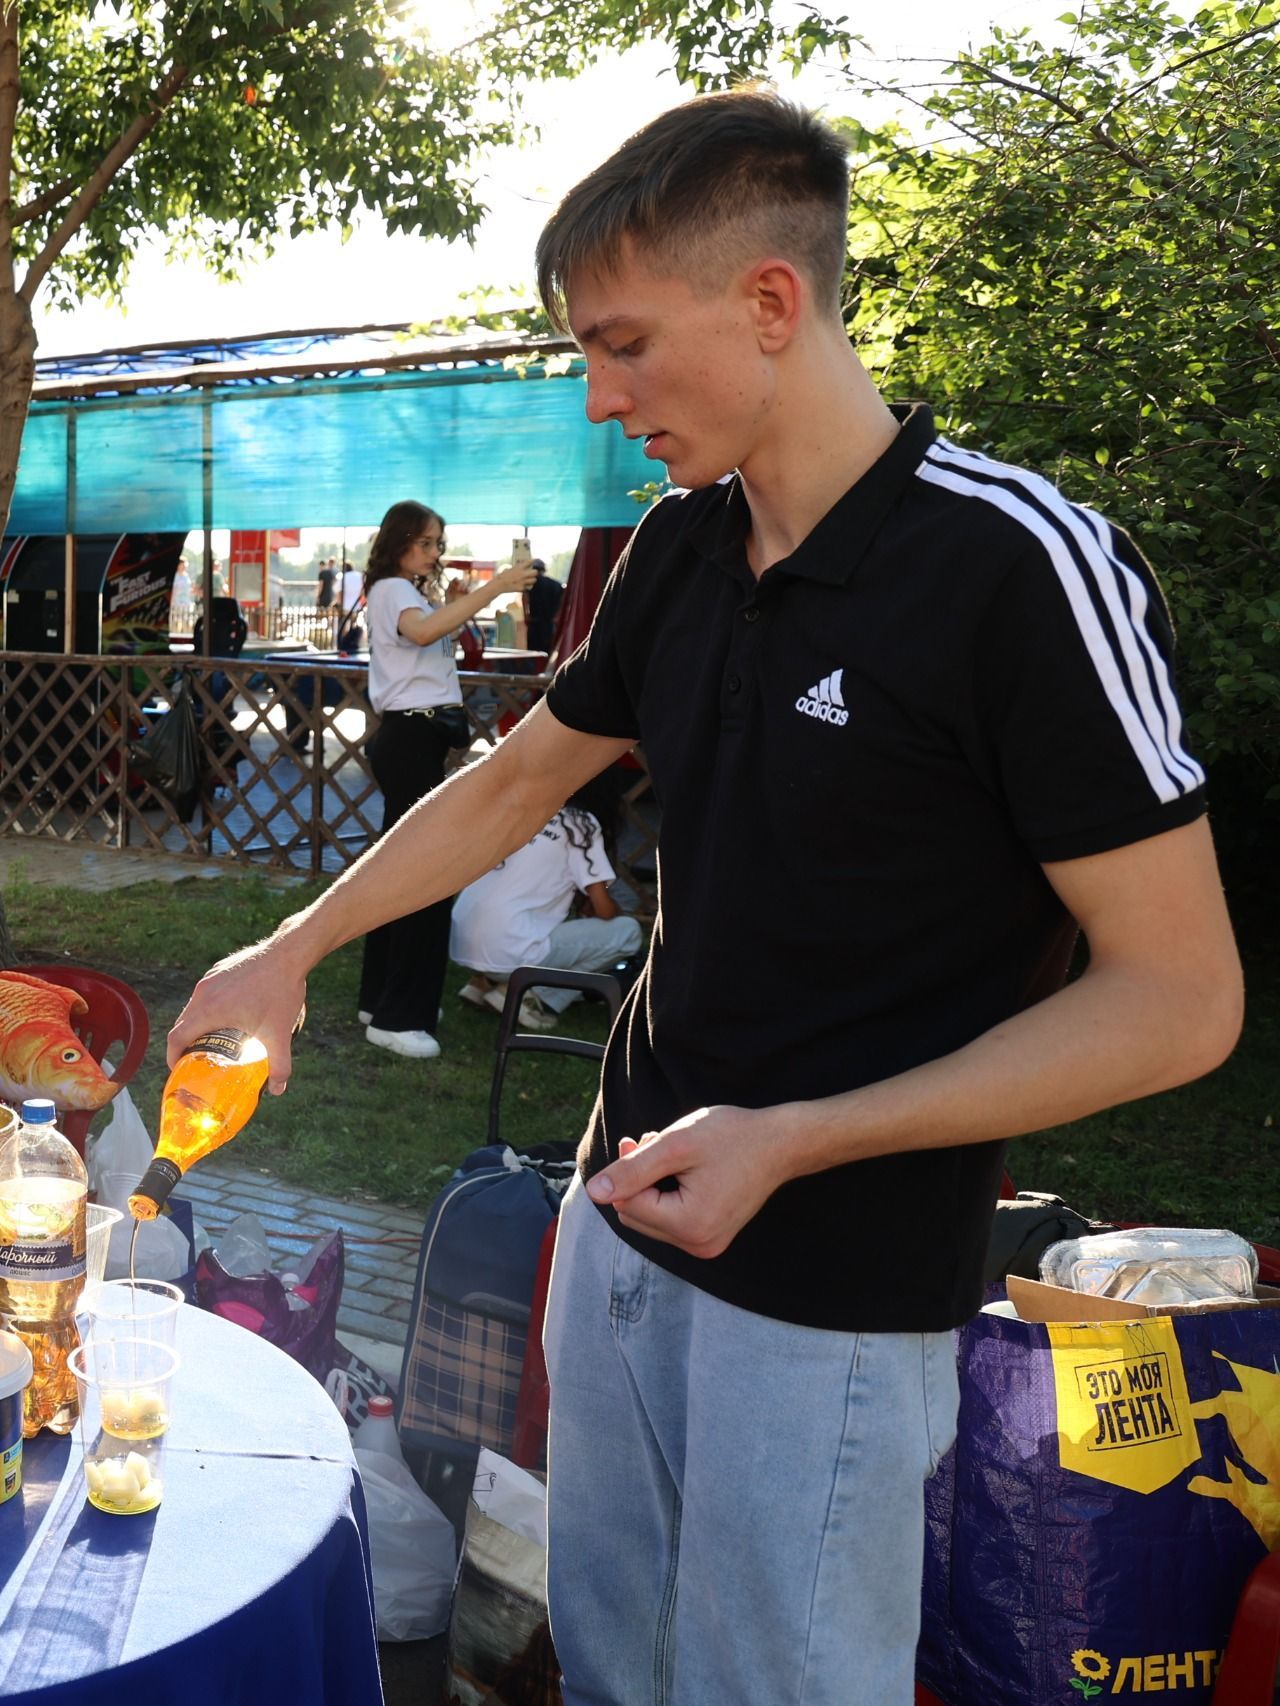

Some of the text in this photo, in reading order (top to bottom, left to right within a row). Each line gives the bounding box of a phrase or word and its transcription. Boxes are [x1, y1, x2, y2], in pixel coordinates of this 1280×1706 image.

[795, 696, 849, 726] adidas
[207, 1038, 237, 1050] YELLOW
[1086, 1361, 1163, 1400] ЭТО МОЯ
[1094, 1392, 1175, 1445] ЛЕНТА
[1111, 1650, 1220, 1694] ЛЕНТ
